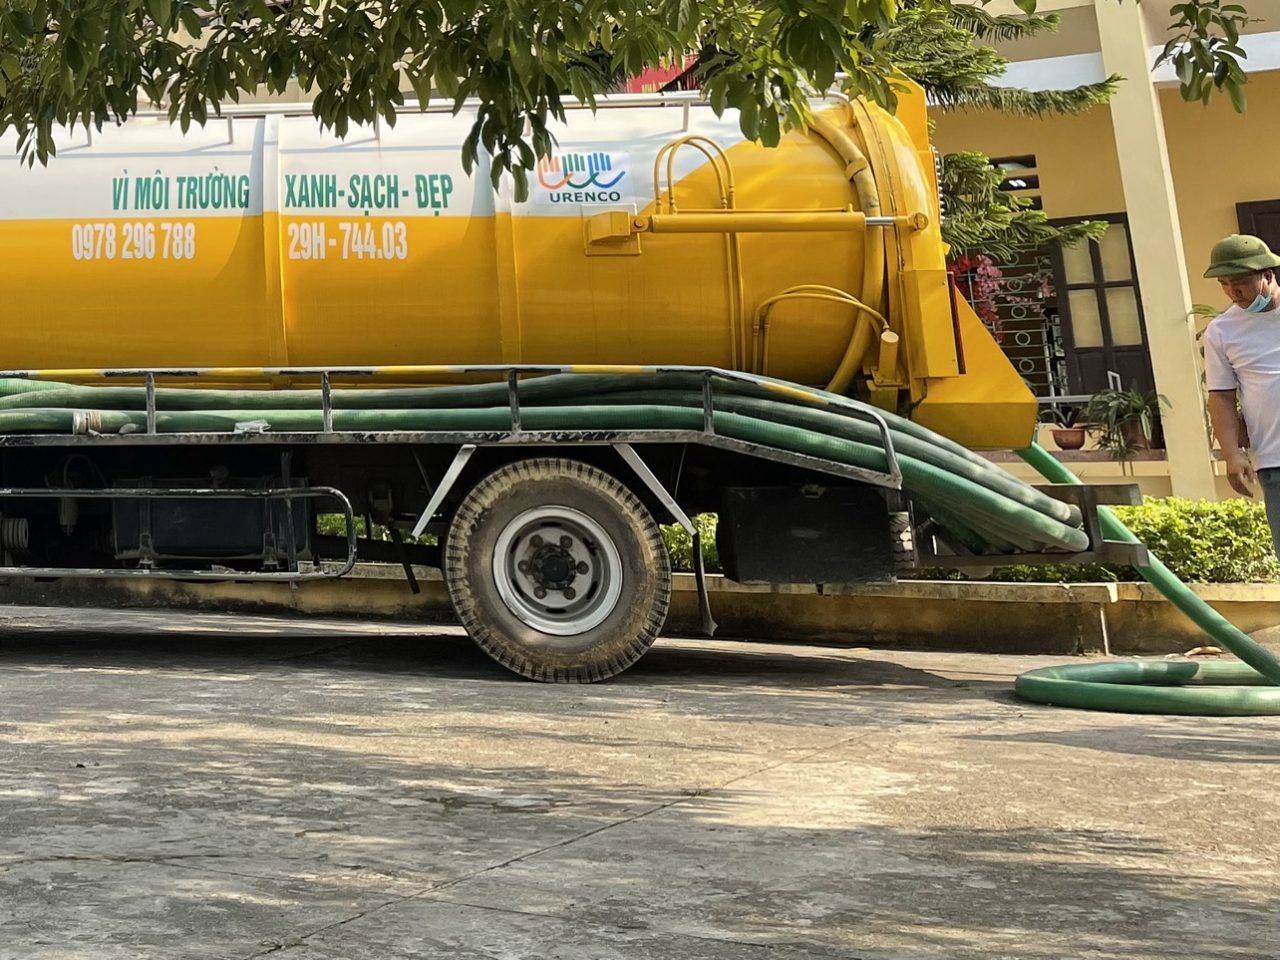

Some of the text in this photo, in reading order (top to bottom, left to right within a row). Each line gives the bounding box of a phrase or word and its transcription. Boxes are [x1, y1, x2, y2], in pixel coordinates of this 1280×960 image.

[112, 169, 129, 210] VÌ
[134, 169, 170, 210] MÔI
[176, 166, 250, 209] TRƯỜNG
[415, 174, 453, 216] ĐẸP
[549, 191, 621, 203] URENCO
[72, 222, 196, 260] 0978 296 788
